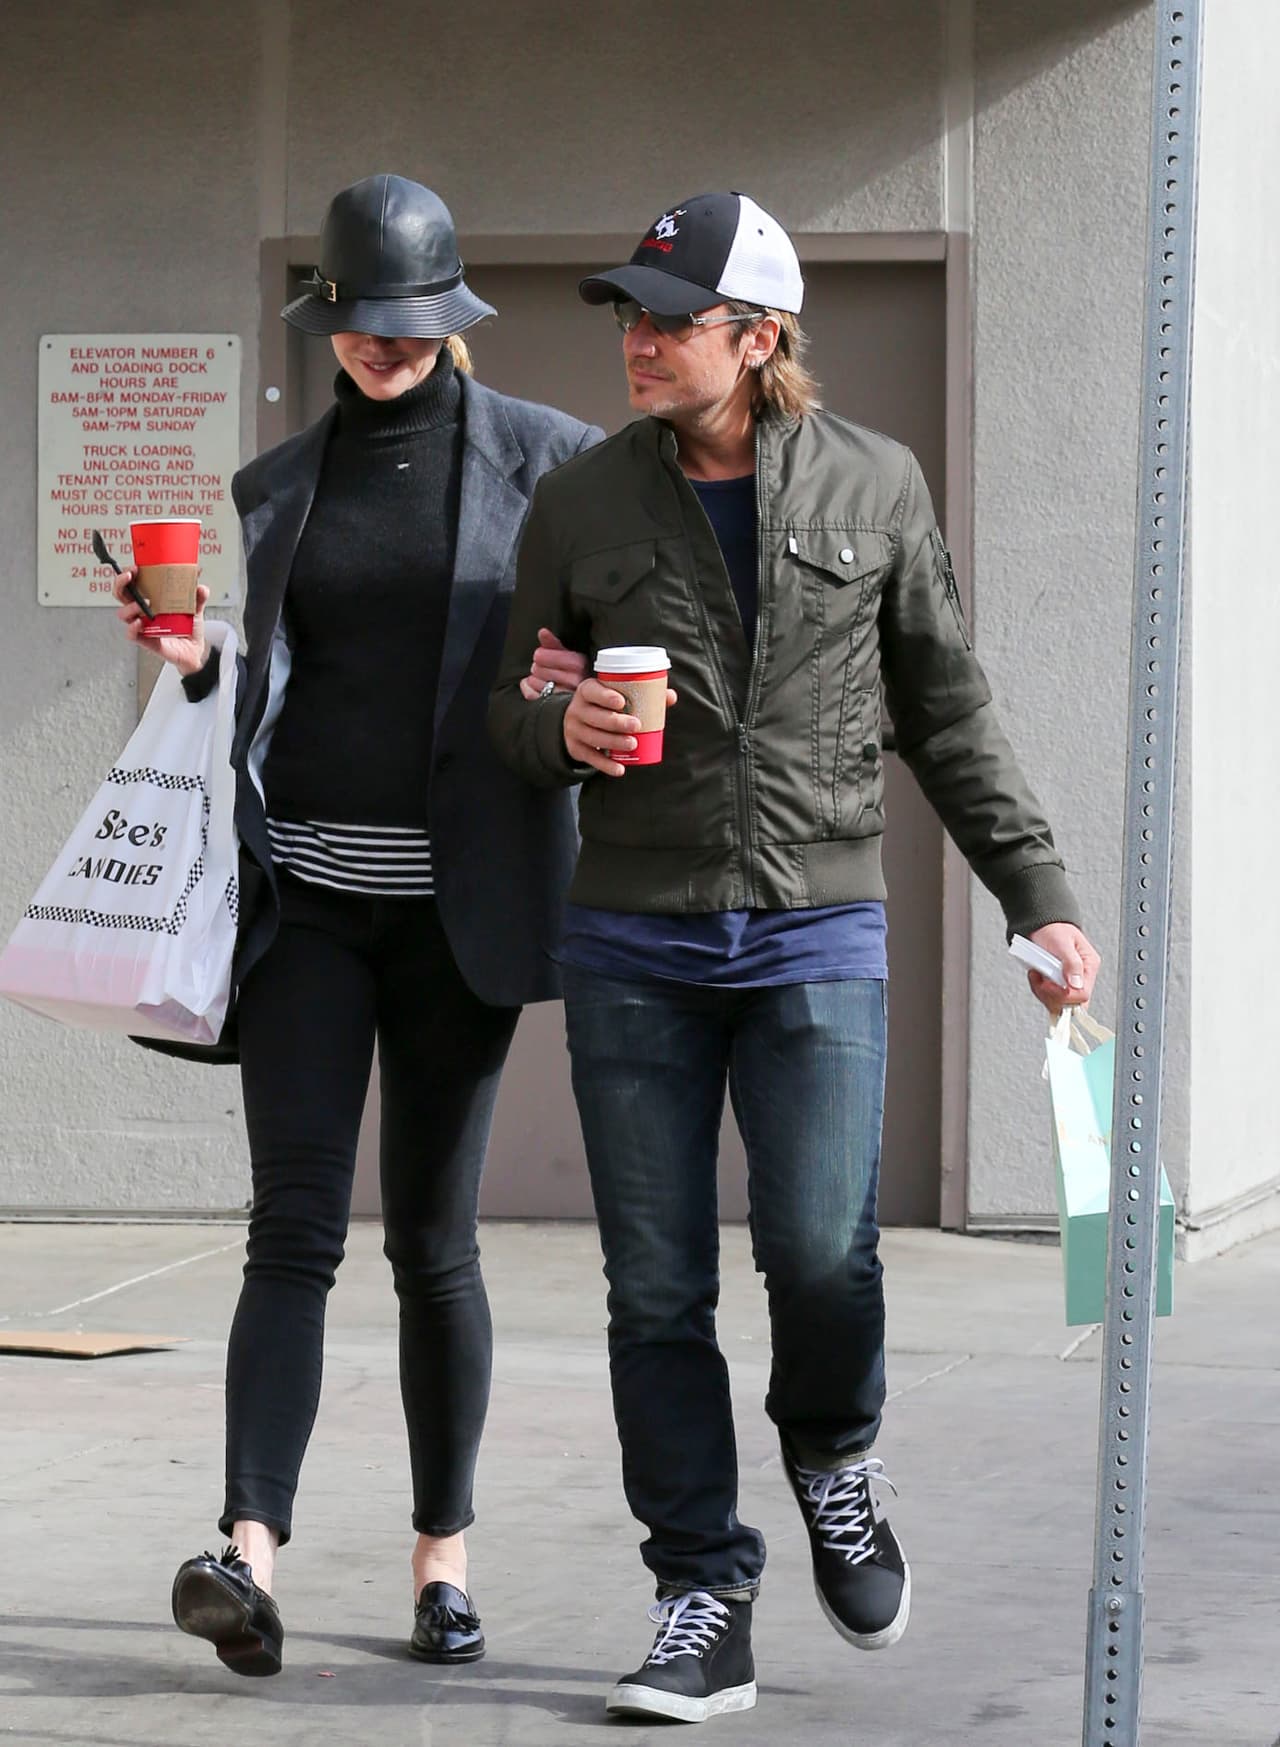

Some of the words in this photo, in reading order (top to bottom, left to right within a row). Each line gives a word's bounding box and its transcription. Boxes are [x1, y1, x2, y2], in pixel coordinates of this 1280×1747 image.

[70, 348, 135, 359] ELEVATOR
[141, 348, 198, 359] NUMBER
[206, 348, 215, 360] 6
[71, 362, 99, 374] AND
[104, 362, 163, 374] LOADING
[169, 362, 208, 373] DOCK
[99, 377, 147, 388] HOURS
[152, 377, 179, 388] ARE
[51, 392, 114, 403] 8AM-8PM
[120, 392, 227, 403] MONDAY-FRIDAY
[72, 407, 138, 417] 5AM-10PM
[143, 407, 207, 417] SATURDAY
[82, 421, 141, 431] 9AM-7PM
[146, 421, 196, 431] SUNDAY
[83, 445, 127, 456] TRUCK
[83, 460, 160, 471] UNLOADING
[166, 460, 194, 471] AND
[57, 475, 109, 485] TENANT
[115, 475, 221, 486] CONSTRUCTION
[51, 490, 88, 500] MUST
[94, 490, 142, 500] OCCUR
[147, 490, 193, 500] WITHIN
[199, 490, 225, 500] THE
[61, 504, 109, 516] HOURS
[114, 504, 163, 515] STATED
[169, 504, 214, 515] ABOVE
[58, 528, 78, 539] NO
[83, 528, 126, 539] ETRY
[54, 543, 113, 554] WITHOT
[71, 567, 87, 578] 24
[94, 809, 168, 848] See's
